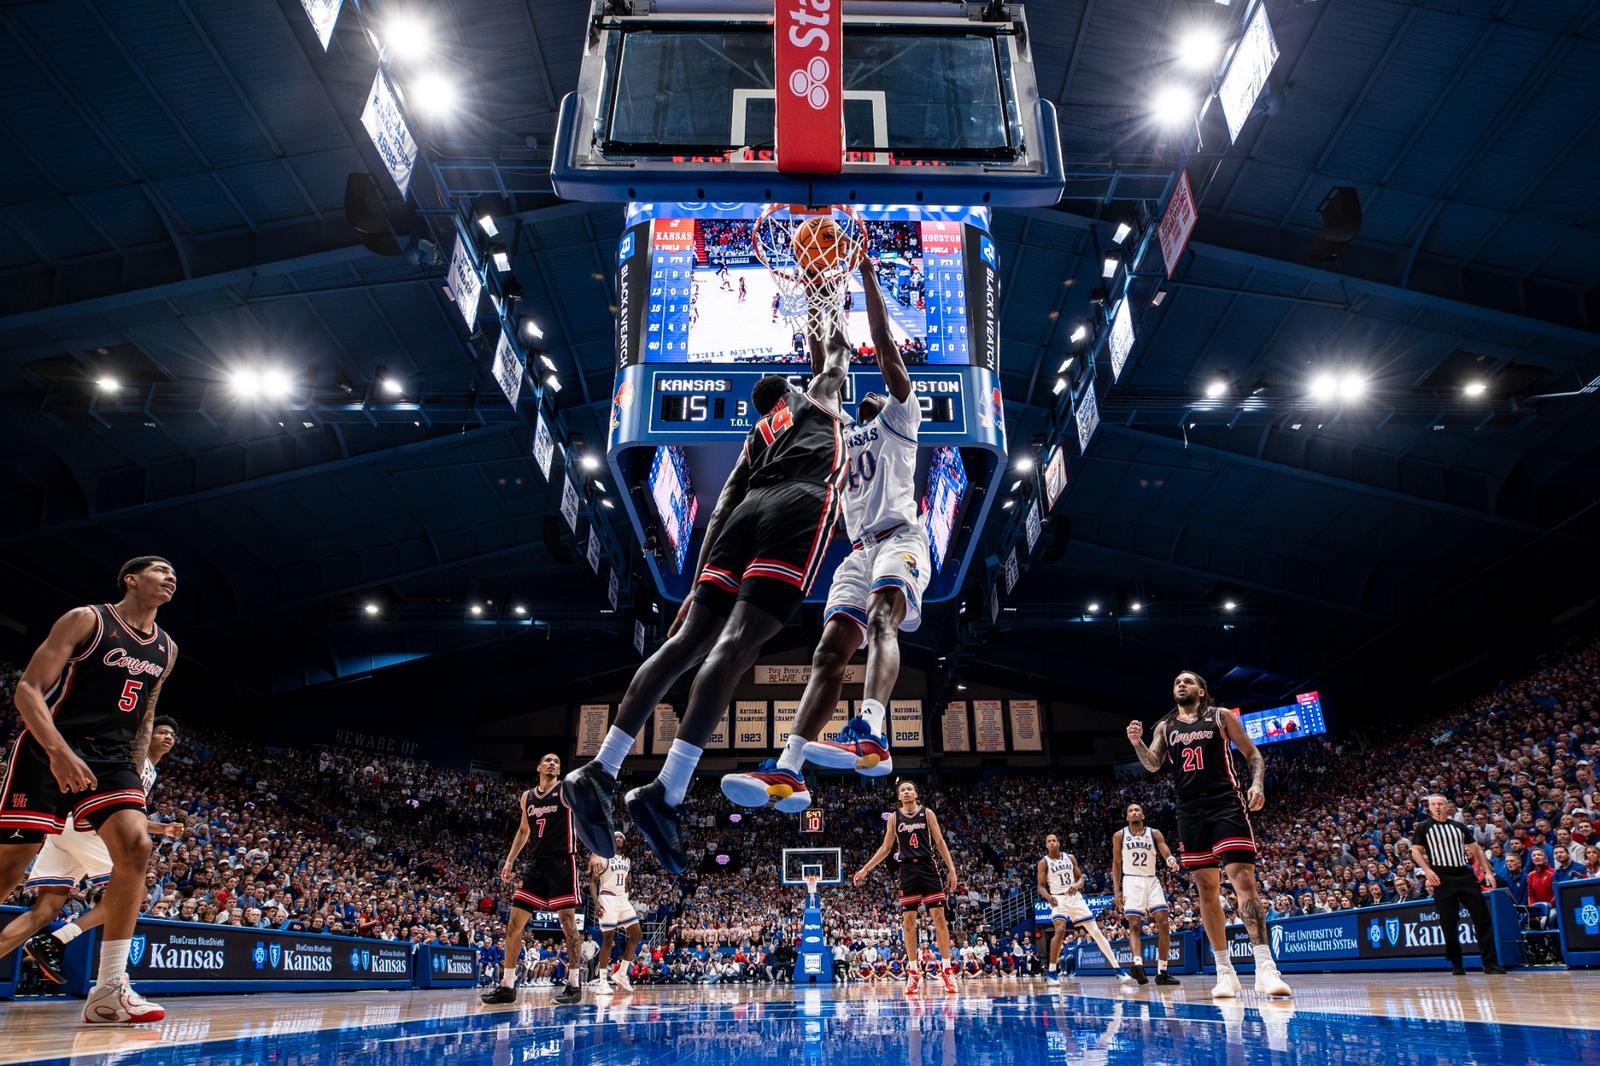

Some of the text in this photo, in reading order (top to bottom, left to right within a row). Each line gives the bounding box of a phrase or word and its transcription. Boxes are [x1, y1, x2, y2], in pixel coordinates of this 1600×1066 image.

[655, 231, 694, 242] KANSAS
[922, 234, 961, 242] HOUSTON
[620, 264, 628, 306] BLACK
[620, 316, 628, 368] VEATCH
[986, 319, 994, 370] VEATCH
[660, 380, 726, 392] KANSAS
[682, 395, 708, 421] 15
[738, 401, 748, 416] 3
[730, 418, 752, 427] T.O.L.
[755, 406, 794, 448] 14
[848, 428, 879, 448] NSAS
[103, 648, 164, 678] Cougars
[769, 674, 798, 682] BEWARE
[118, 679, 144, 712] 5
[336, 728, 396, 752] BEWARE
[709, 734, 723, 742] 22
[741, 733, 761, 742] 1923
[824, 732, 841, 742] 198
[896, 732, 919, 741] 2022
[1169, 730, 1213, 746] Cougars
[1182, 746, 1204, 772] 21
[536, 818, 546, 838] 7
[808, 818, 820, 830] 10
[910, 832, 918, 848] 4
[1126, 842, 1152, 850] KANSAS
[1132, 852, 1148, 866] 22
[1050, 864, 1072, 872] KANSAS
[616, 874, 624, 886] 11
[1058, 872, 1072, 886] 13
[170, 935, 224, 946] BlueCross BlueShield
[1284, 926, 1343, 941] THE UNIVERSITY OF
[1404, 922, 1478, 948] Kanas
[1227, 940, 1253, 957] Kans
[1285, 938, 1358, 952] KANSAS HEALTH SYSTEM
[149, 943, 224, 969] Kansas
[284, 950, 332, 971] Kansas
[371, 955, 406, 973] Kansas
[447, 959, 472, 974] Kansas
